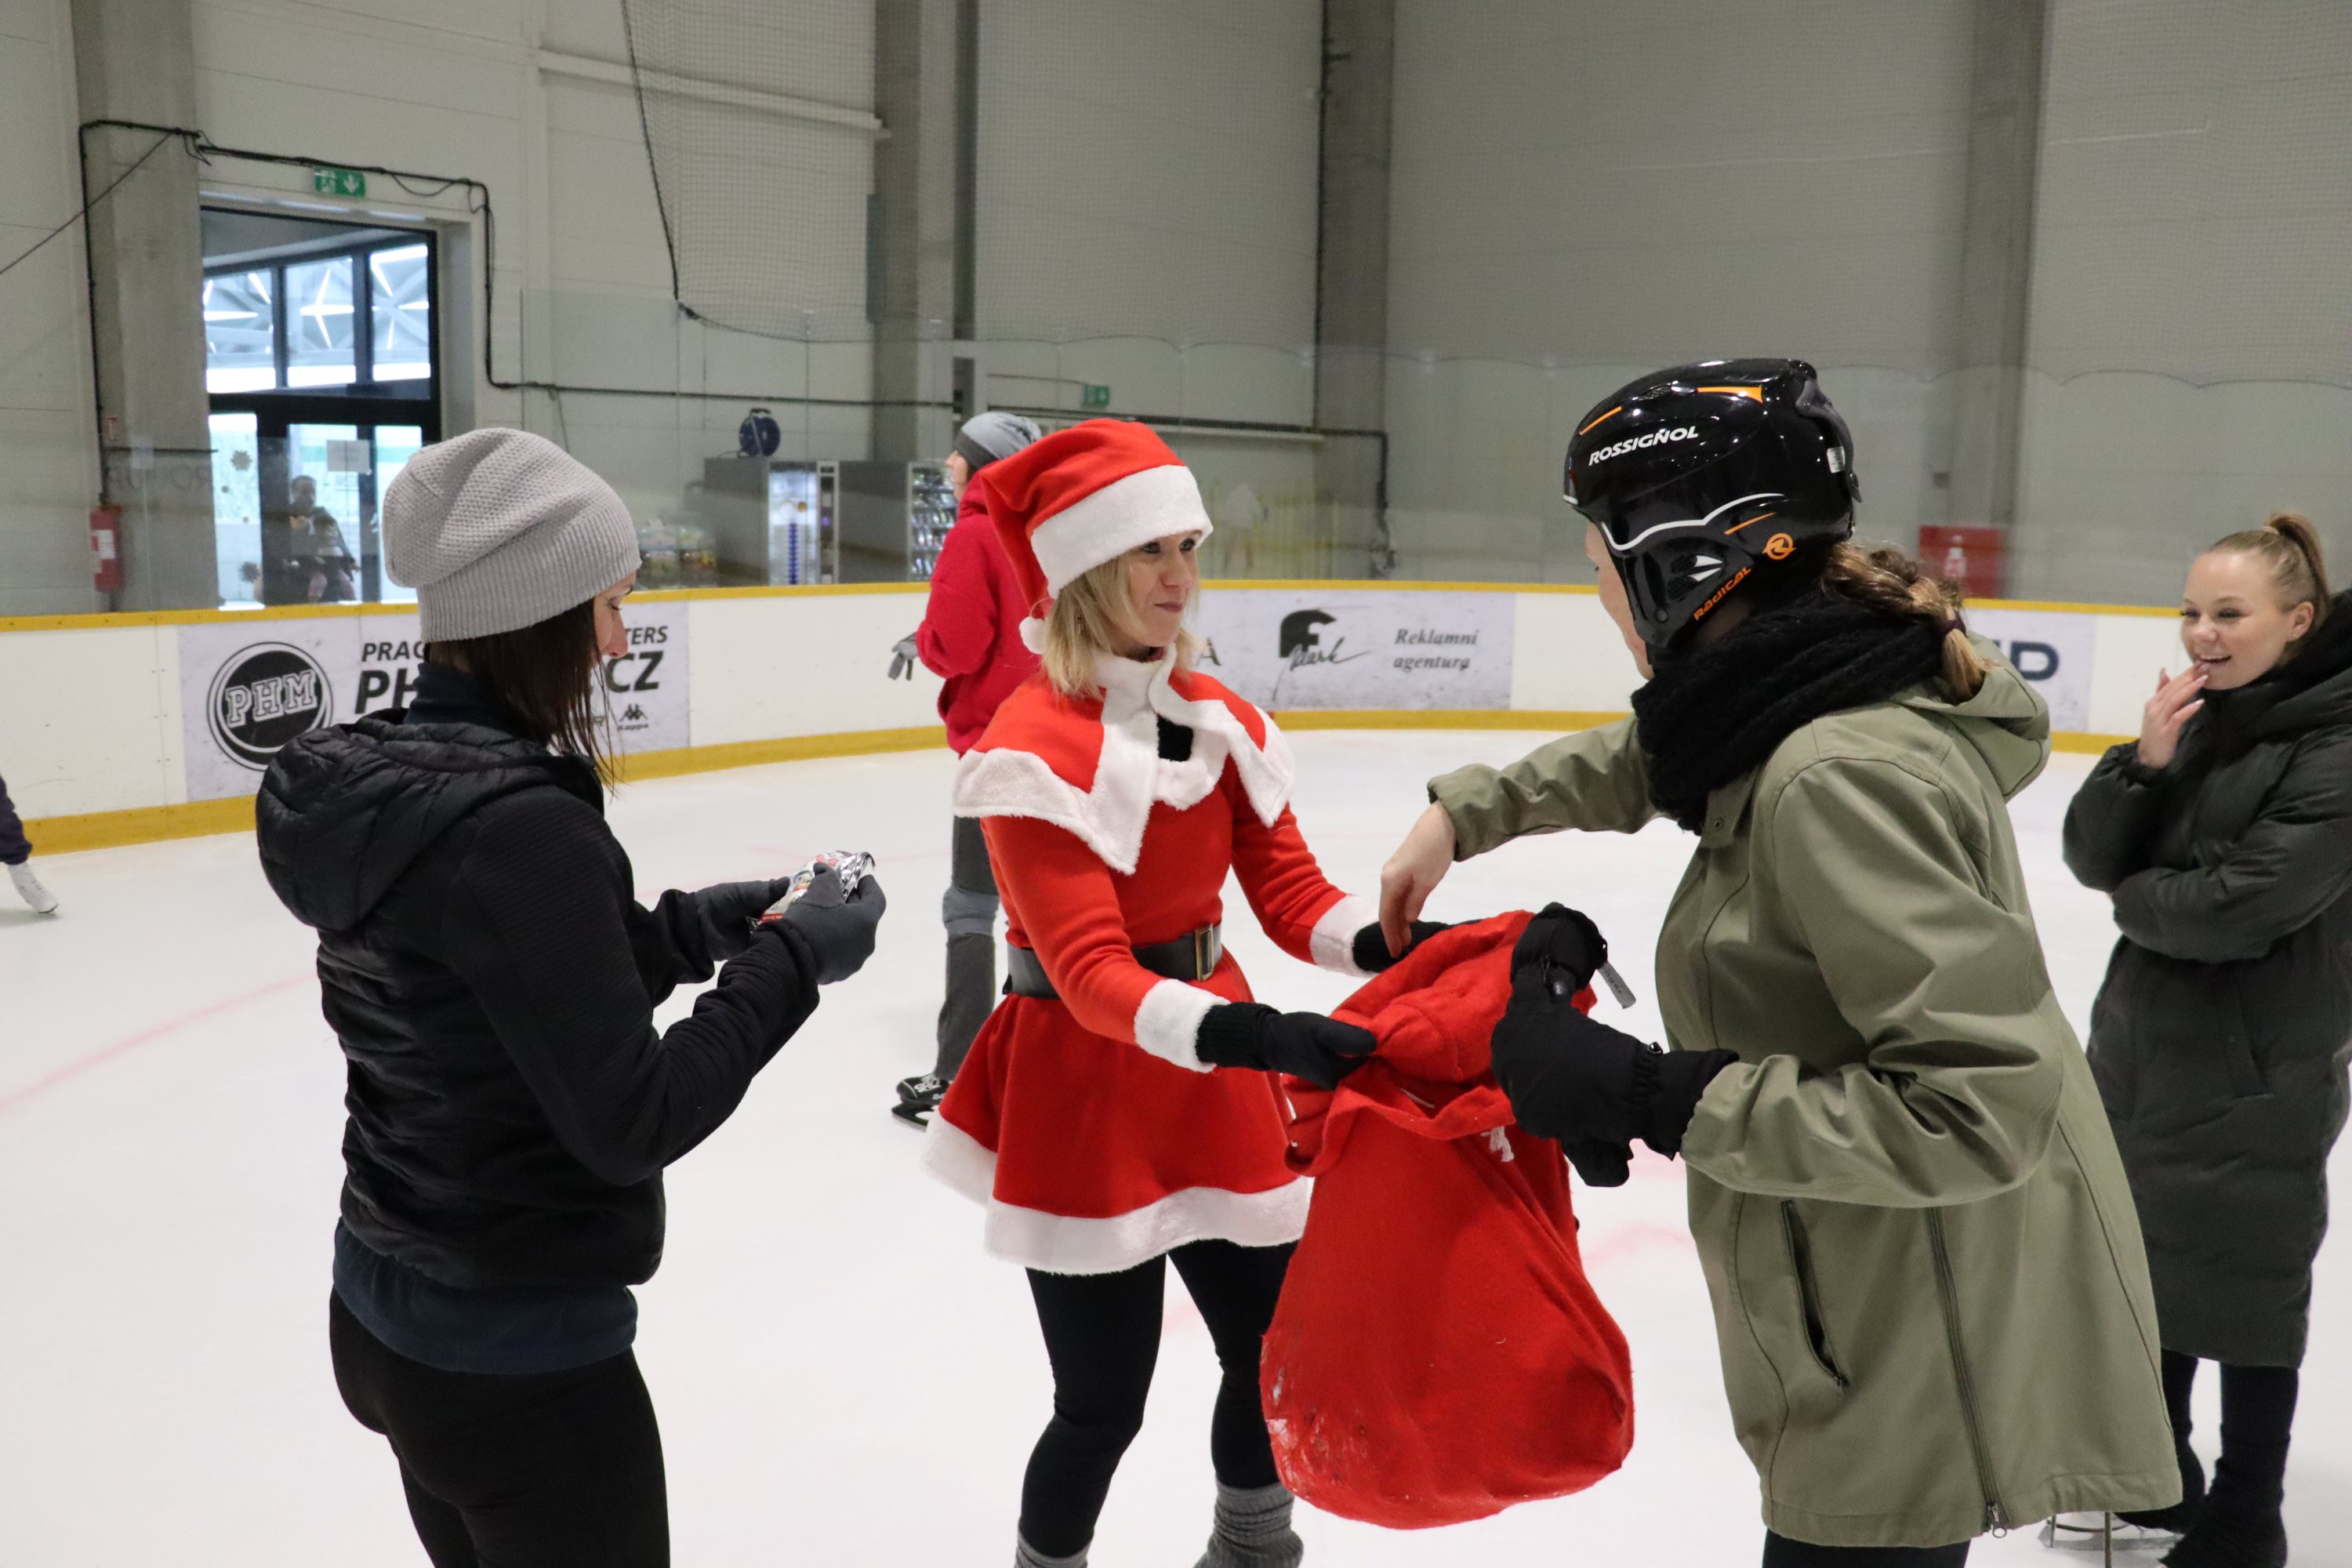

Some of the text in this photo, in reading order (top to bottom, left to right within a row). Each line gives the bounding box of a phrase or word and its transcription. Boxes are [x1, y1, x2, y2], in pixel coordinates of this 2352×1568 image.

[1588, 426, 1699, 466] ROSSIGNOL
[1395, 628, 1481, 644] Reklamní
[1393, 656, 1471, 673] agentura
[225, 669, 318, 728] PHM
